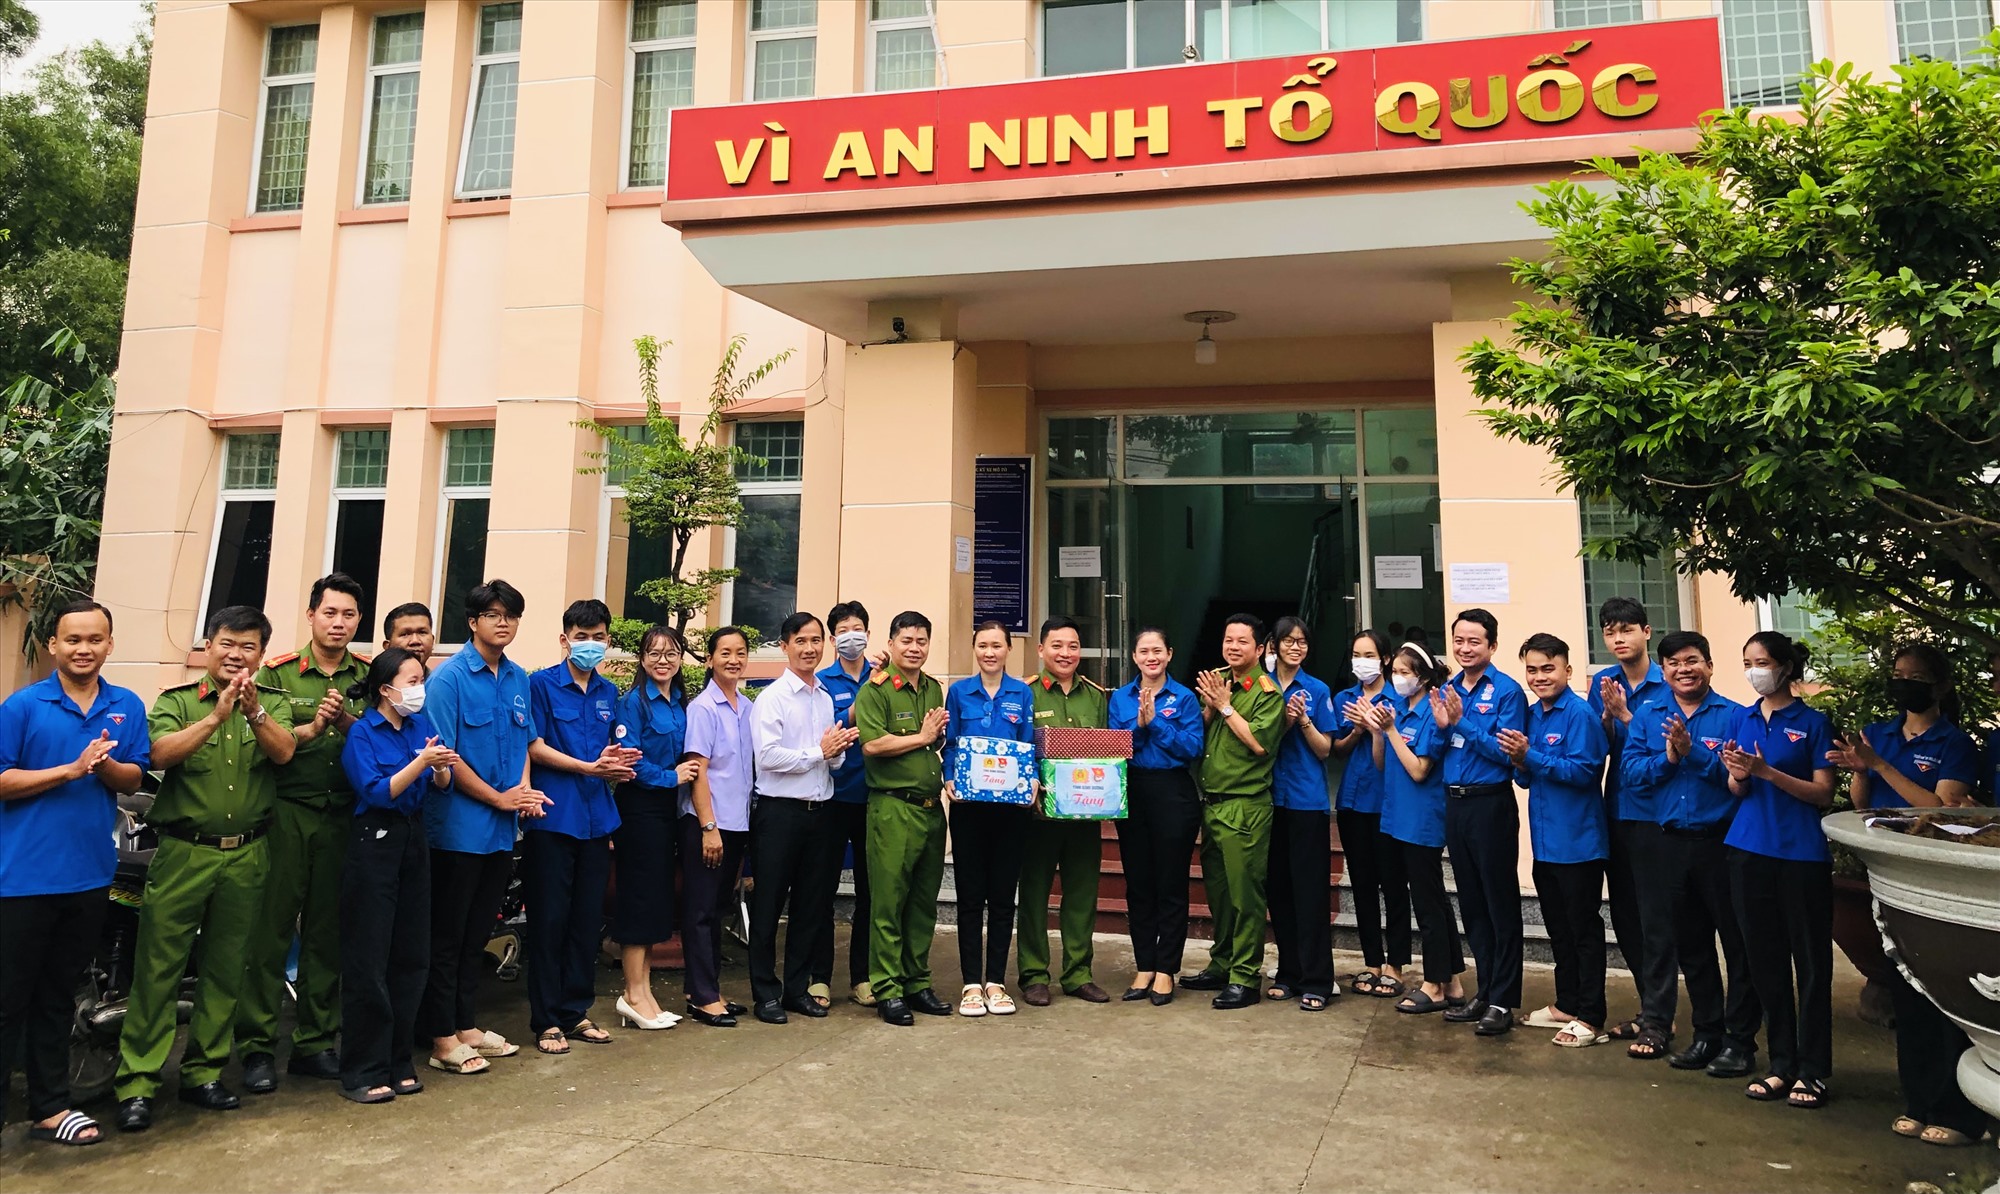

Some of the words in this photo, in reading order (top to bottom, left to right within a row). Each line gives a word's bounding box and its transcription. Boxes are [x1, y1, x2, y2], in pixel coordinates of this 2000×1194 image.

[715, 122, 790, 184] VÌ
[823, 125, 934, 180] AN
[968, 105, 1169, 169] NINH
[1206, 57, 1338, 149] TỔ
[1375, 40, 1659, 141] QUỐC
